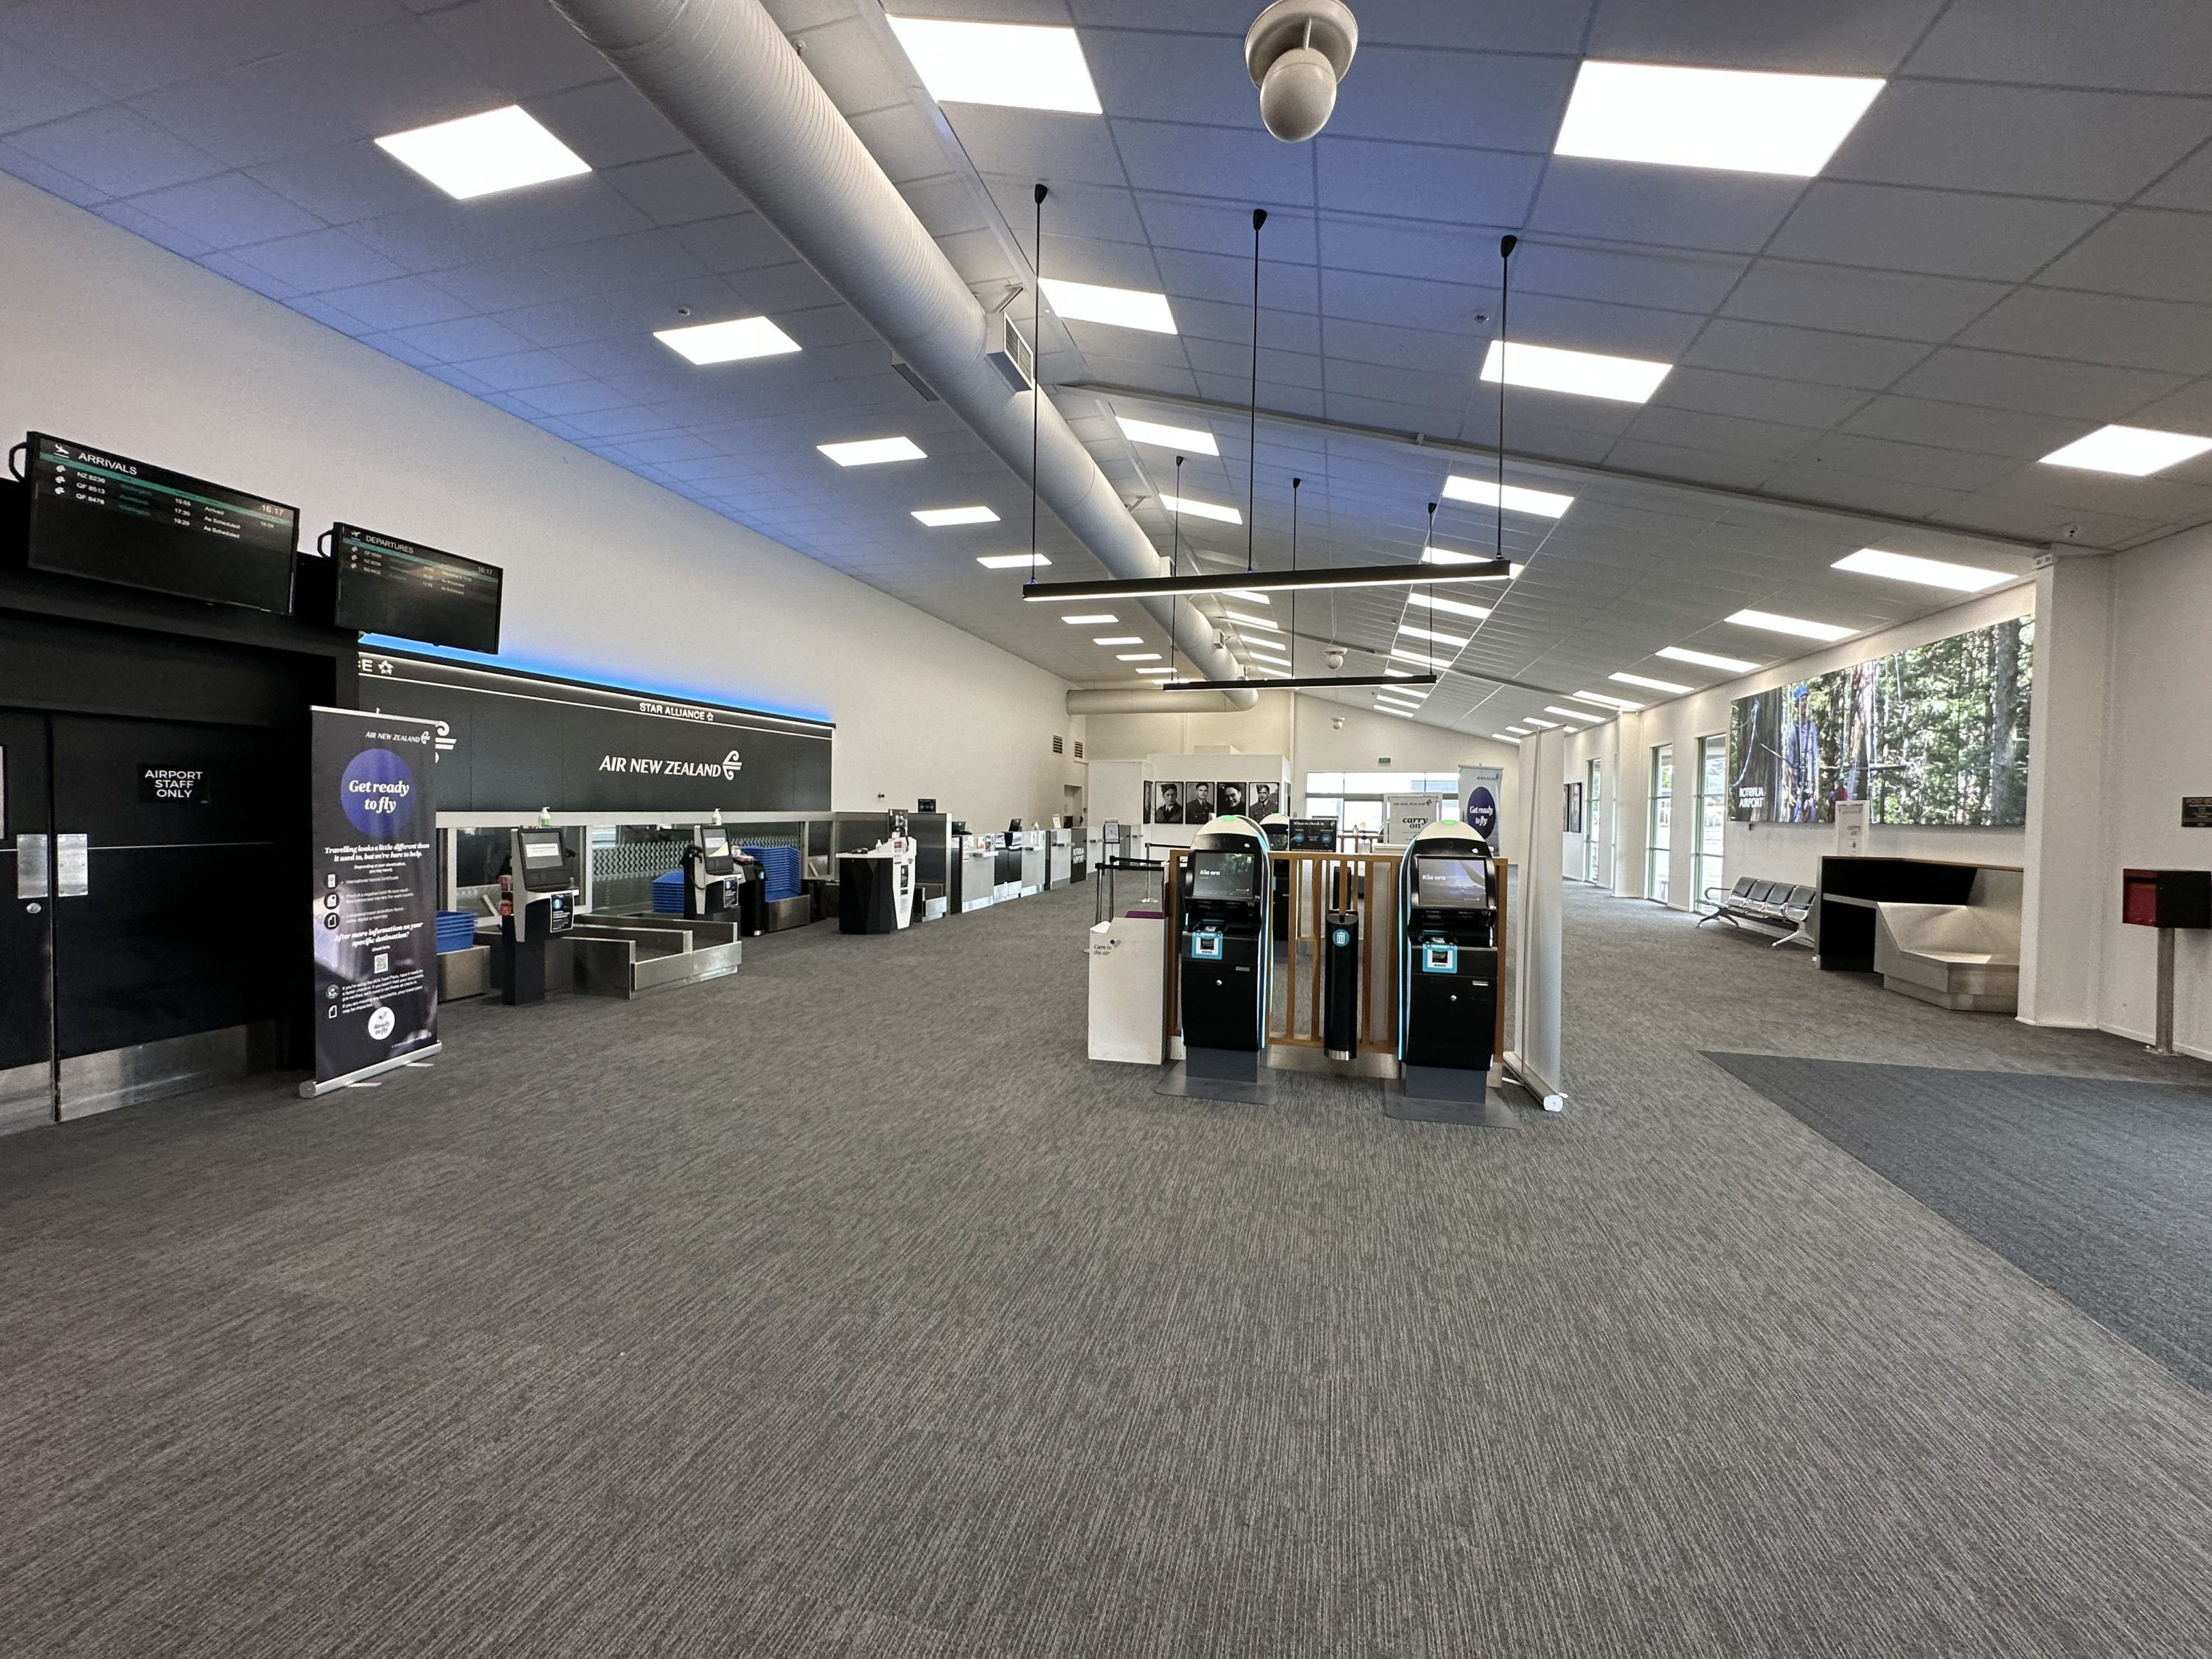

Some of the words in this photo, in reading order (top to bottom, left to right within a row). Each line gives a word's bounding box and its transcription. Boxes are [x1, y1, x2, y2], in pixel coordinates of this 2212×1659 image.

[78, 452, 137, 476] ARRIVALS
[205, 506, 224, 515] Arrived
[261, 504, 284, 516] 16:17
[175, 507, 190, 516] 17:30
[213, 518, 240, 529] Scheduled
[173, 518, 189, 526] 19:20
[212, 526, 240, 538] Scheduled
[366, 535, 414, 554] DEPARTURES
[478, 566, 493, 575] 16:17
[639, 702, 663, 714] STAR
[665, 706, 706, 720] ALLIANCE
[365, 731, 377, 739] AIR
[393, 734, 420, 742] ZEALAND
[599, 755, 627, 772] AIR
[630, 758, 663, 774] NEW
[664, 760, 721, 777] ZEALAND
[145, 770, 204, 780] AIRPORT
[154, 779, 194, 788] STAFF
[349, 780, 371, 793] Get
[373, 780, 410, 796] ready
[156, 789, 192, 798] ONLY
[364, 799, 377, 810] to
[377, 796, 396, 813] fly
[1739, 797, 1764, 808] AIRPORT
[1470, 805, 1478, 814] Get
[1478, 805, 1493, 816] ready
[1402, 817, 1428, 825] carry
[1479, 815, 1488, 827] fly
[324, 845, 358, 854] Travelling
[394, 843, 417, 852] different
[335, 933, 351, 942] After
[368, 925, 403, 936] information
[410, 922, 423, 931] your
[352, 936, 375, 947] specific
[375, 931, 410, 943] destination?
[374, 1020, 390, 1029] Ready
